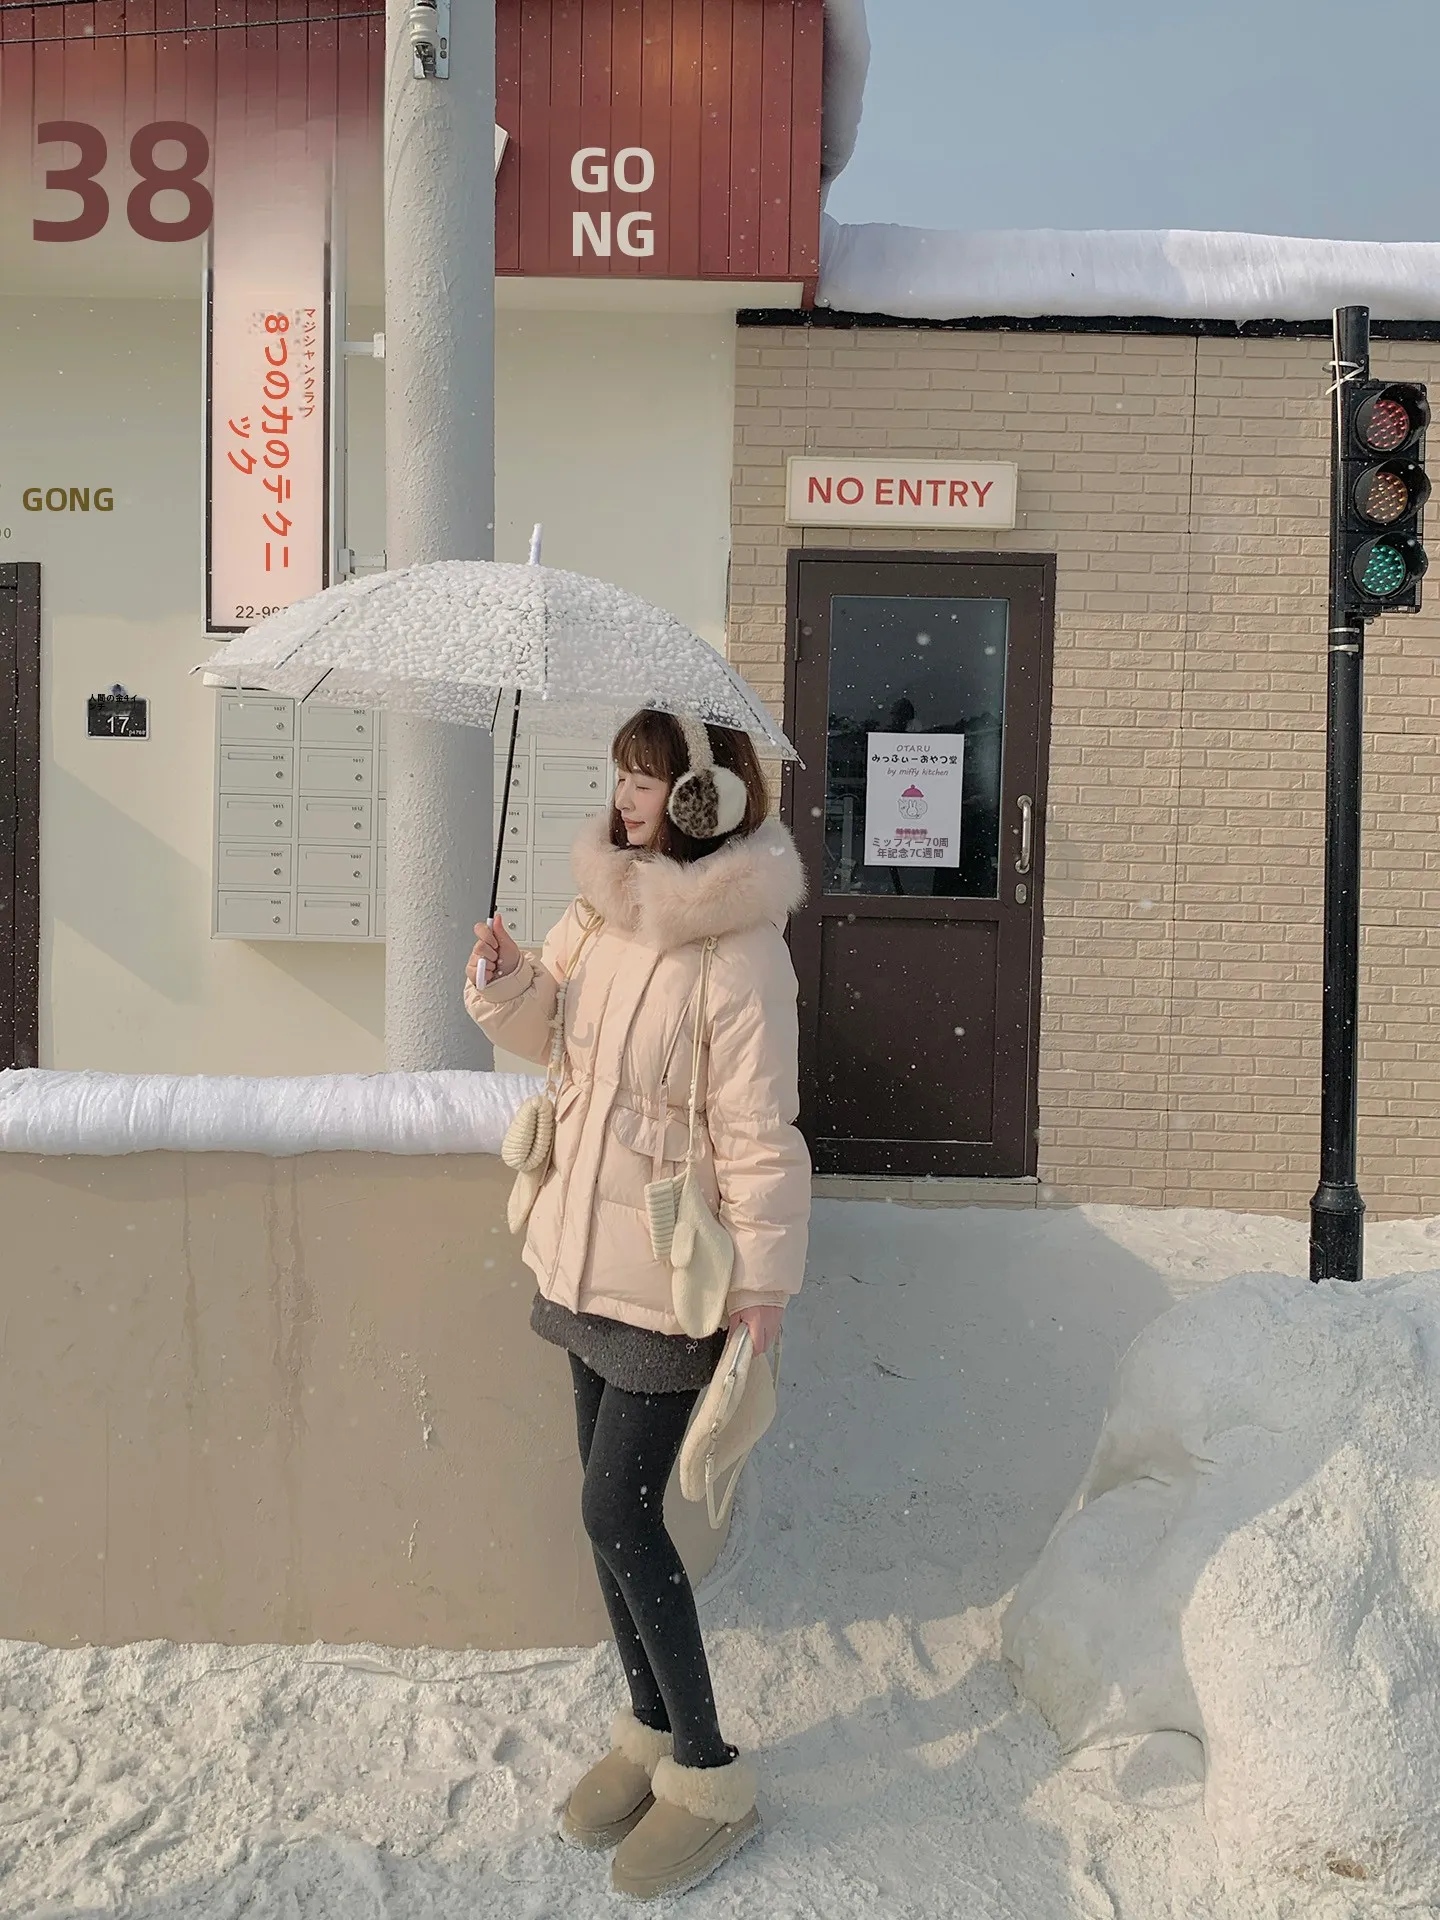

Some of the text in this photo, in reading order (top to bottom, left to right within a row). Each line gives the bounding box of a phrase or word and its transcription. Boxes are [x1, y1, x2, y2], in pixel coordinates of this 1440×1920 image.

[571, 147, 655, 193] GO
[572, 211, 655, 257] NG
[22, 487, 114, 512] GONG
[808, 476, 994, 508] NO ENTRY
[107, 716, 130, 734] 17
[896, 744, 931, 753] OTARU
[887, 767, 949, 777] by miffy kitchen
